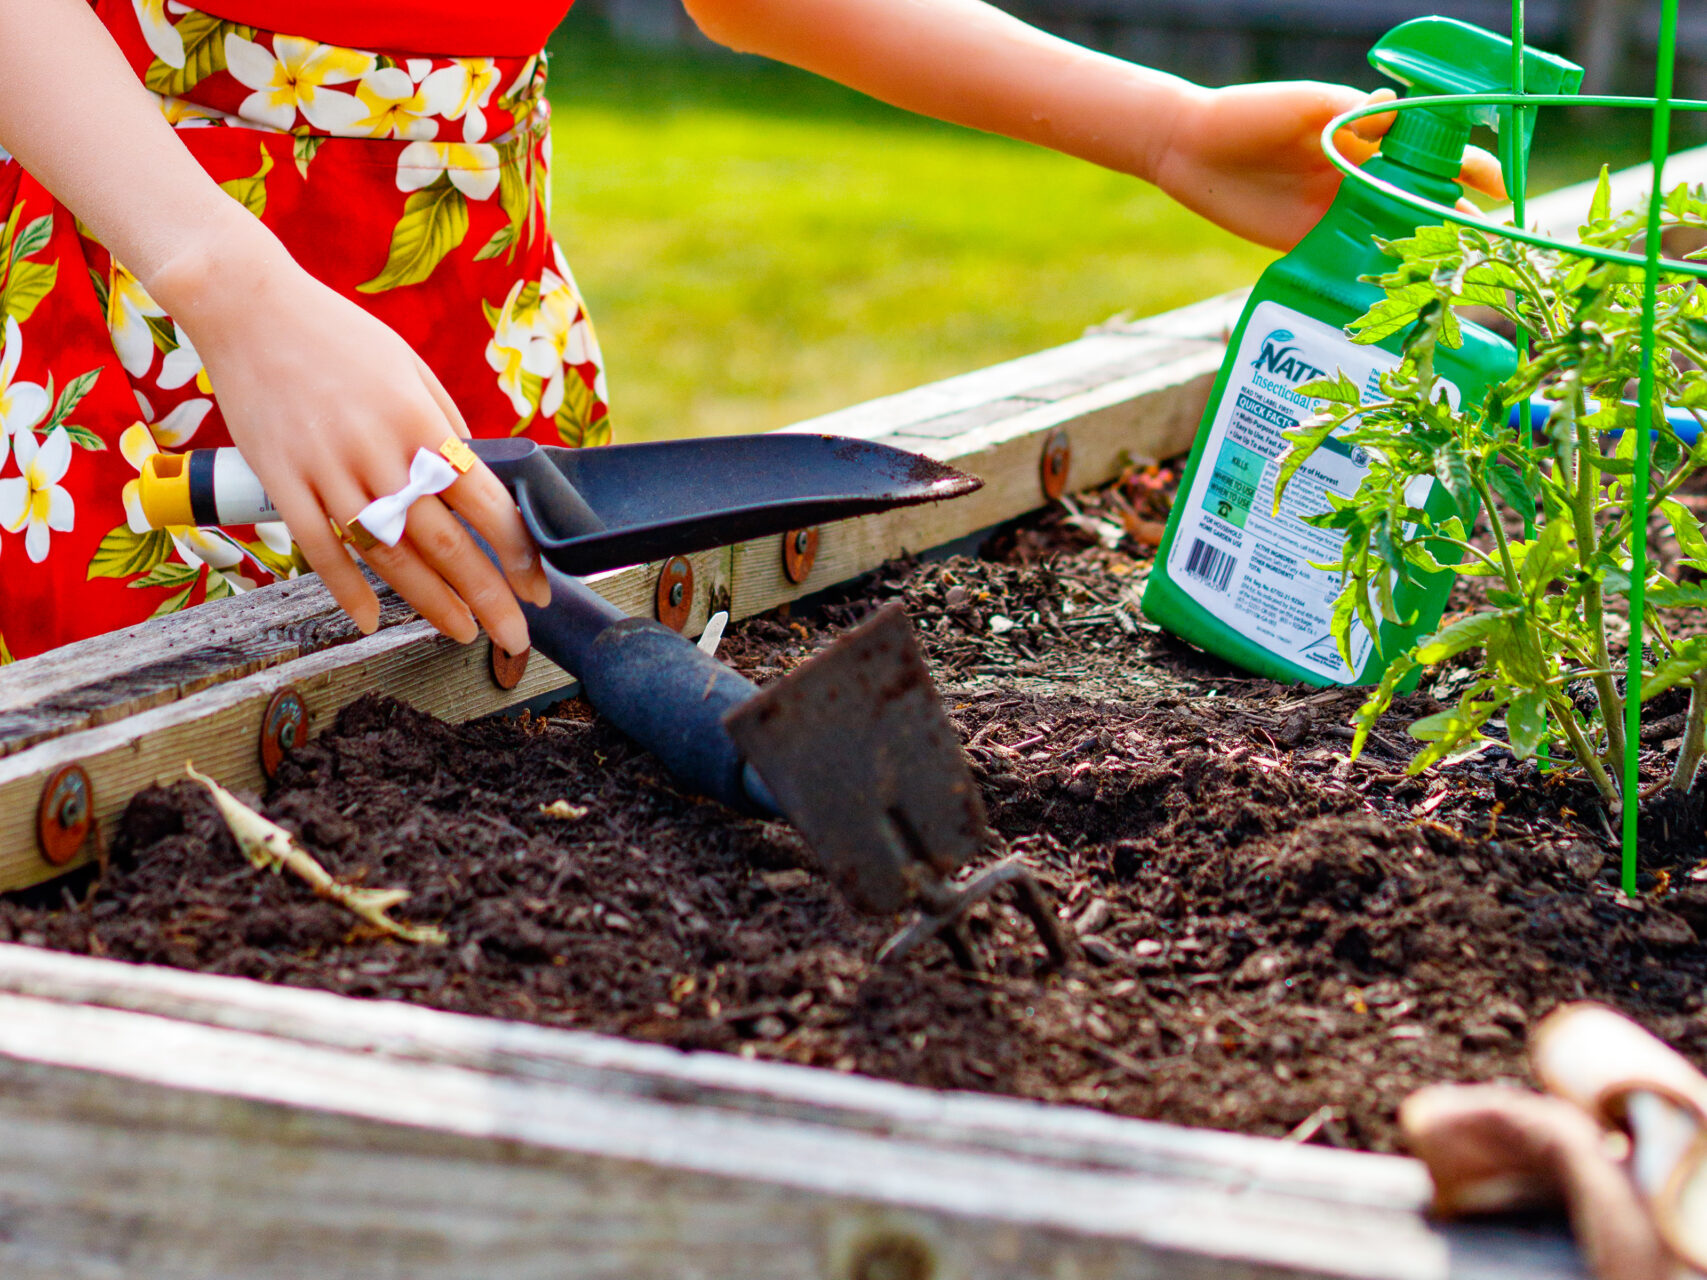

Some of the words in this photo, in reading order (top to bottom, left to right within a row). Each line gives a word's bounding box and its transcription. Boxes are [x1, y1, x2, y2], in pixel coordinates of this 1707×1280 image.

[1252, 370, 1309, 410] Insecticidal
[1239, 397, 1265, 414] QUICK
[1266, 411, 1292, 427] FACTS
